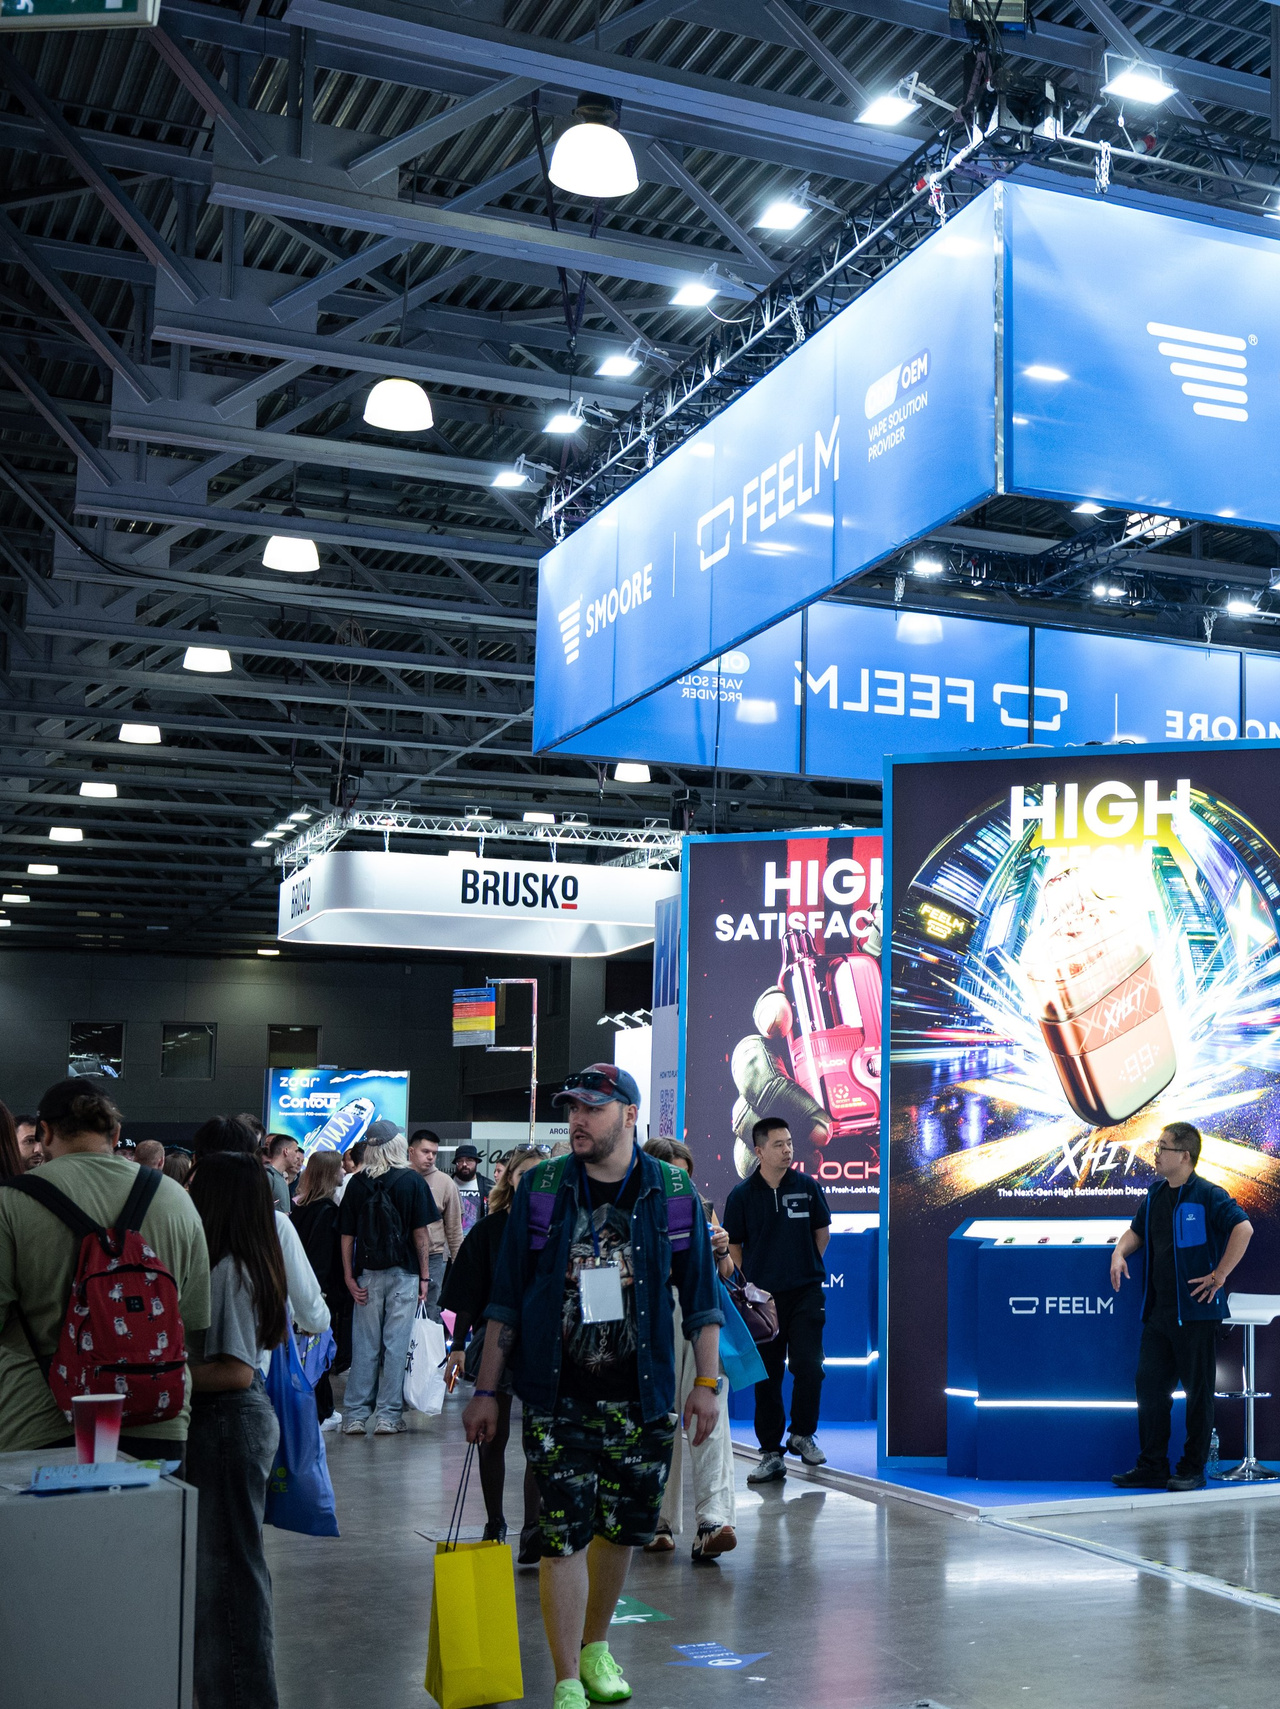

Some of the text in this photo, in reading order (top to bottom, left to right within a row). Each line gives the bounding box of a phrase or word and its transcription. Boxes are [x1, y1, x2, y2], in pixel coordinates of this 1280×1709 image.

[901, 353, 928, 389] OEM
[868, 417, 887, 442] VAPE
[888, 391, 928, 430] SOLUTION
[868, 425, 905, 462] PROVIDER
[742, 414, 840, 544] FEELM
[586, 562, 653, 638] SMOORE
[1010, 778, 1191, 841] HIGH
[291, 876, 311, 919] BRUSKO
[461, 868, 578, 910] BRUSKO
[919, 902, 965, 932] FEELM
[280, 1076, 315, 1091] zgar
[832, 1186, 867, 1194] Fresh-Lock
[998, 1188, 1012, 1197] The
[1014, 1188, 1054, 1197] Next-Gen
[1054, 1187, 1074, 1198] High
[1075, 1186, 1123, 1197] Satisfaction
[1045, 1296, 1114, 1314] FEELM
